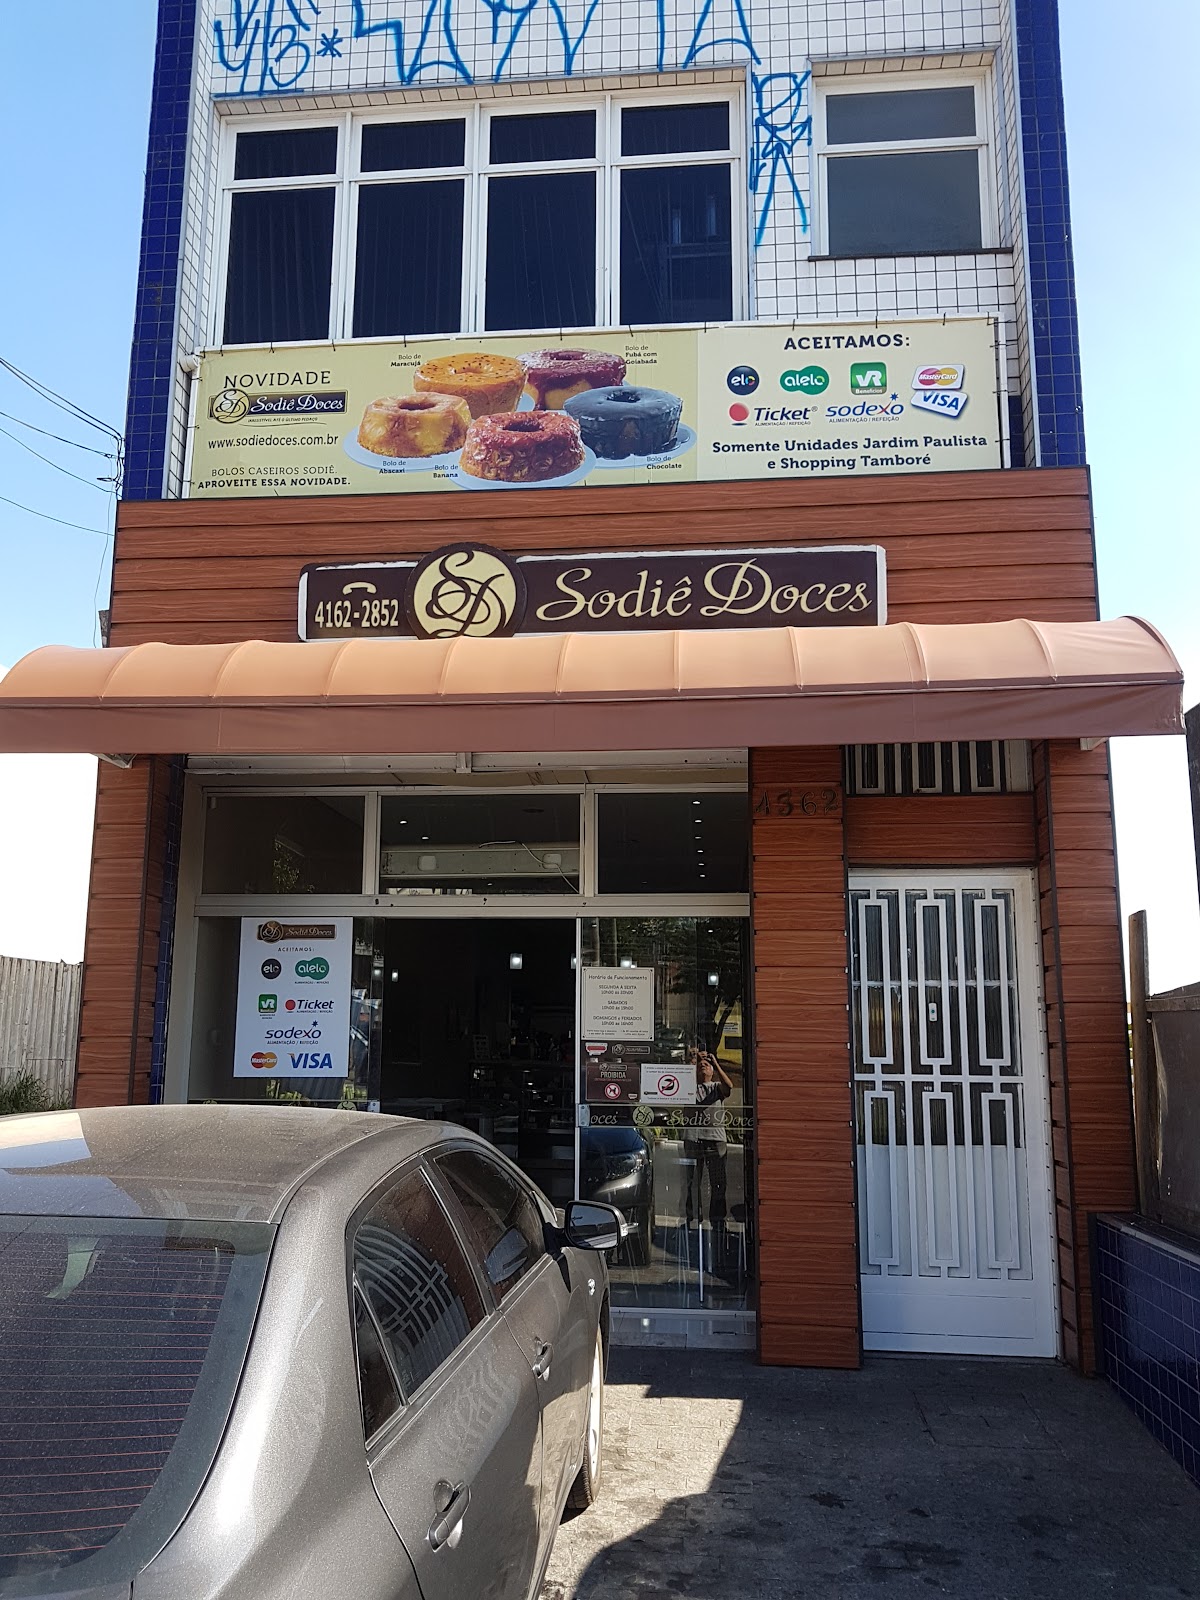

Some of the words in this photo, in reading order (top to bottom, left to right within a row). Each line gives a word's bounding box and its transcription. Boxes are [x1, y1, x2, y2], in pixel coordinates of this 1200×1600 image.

[784, 333, 911, 350] ACEITAMOS:
[223, 370, 331, 388] NOVIDADE
[731, 374, 756, 386] elo
[784, 373, 825, 387] alelo
[251, 396, 295, 412] Sodiê
[296, 394, 343, 411] Doces
[922, 390, 960, 411] VISA
[825, 401, 904, 417] sodexo
[208, 433, 339, 449] www.sodiedoces.com.br
[712, 440, 781, 453] Somente
[784, 438, 858, 452] Unidades
[862, 436, 919, 450] Jardim
[923, 434, 988, 448] Paulista
[767, 459, 776, 469] e
[780, 456, 856, 471] Shopping
[860, 453, 931, 467] Tamboré
[211, 467, 245, 477] BOLOS
[248, 466, 299, 475] CASEIROS
[198, 478, 257, 489] APROVEITE
[261, 478, 286, 487] ESSA
[290, 477, 351, 486] NOVIDADE.
[536, 566, 692, 622] Sodiê
[699, 557, 873, 617] Doces
[314, 599, 399, 628] 4162-2852
[298, 963, 326, 973] alelo
[297, 999, 334, 1010] Ticket
[264, 1026, 322, 1039] sodexo
[287, 1053, 333, 1069] VISA
[600, 1071, 626, 1079] PROIBIDA
[590, 1114, 618, 1124] oces
[712, 1108, 754, 1127] Doce
